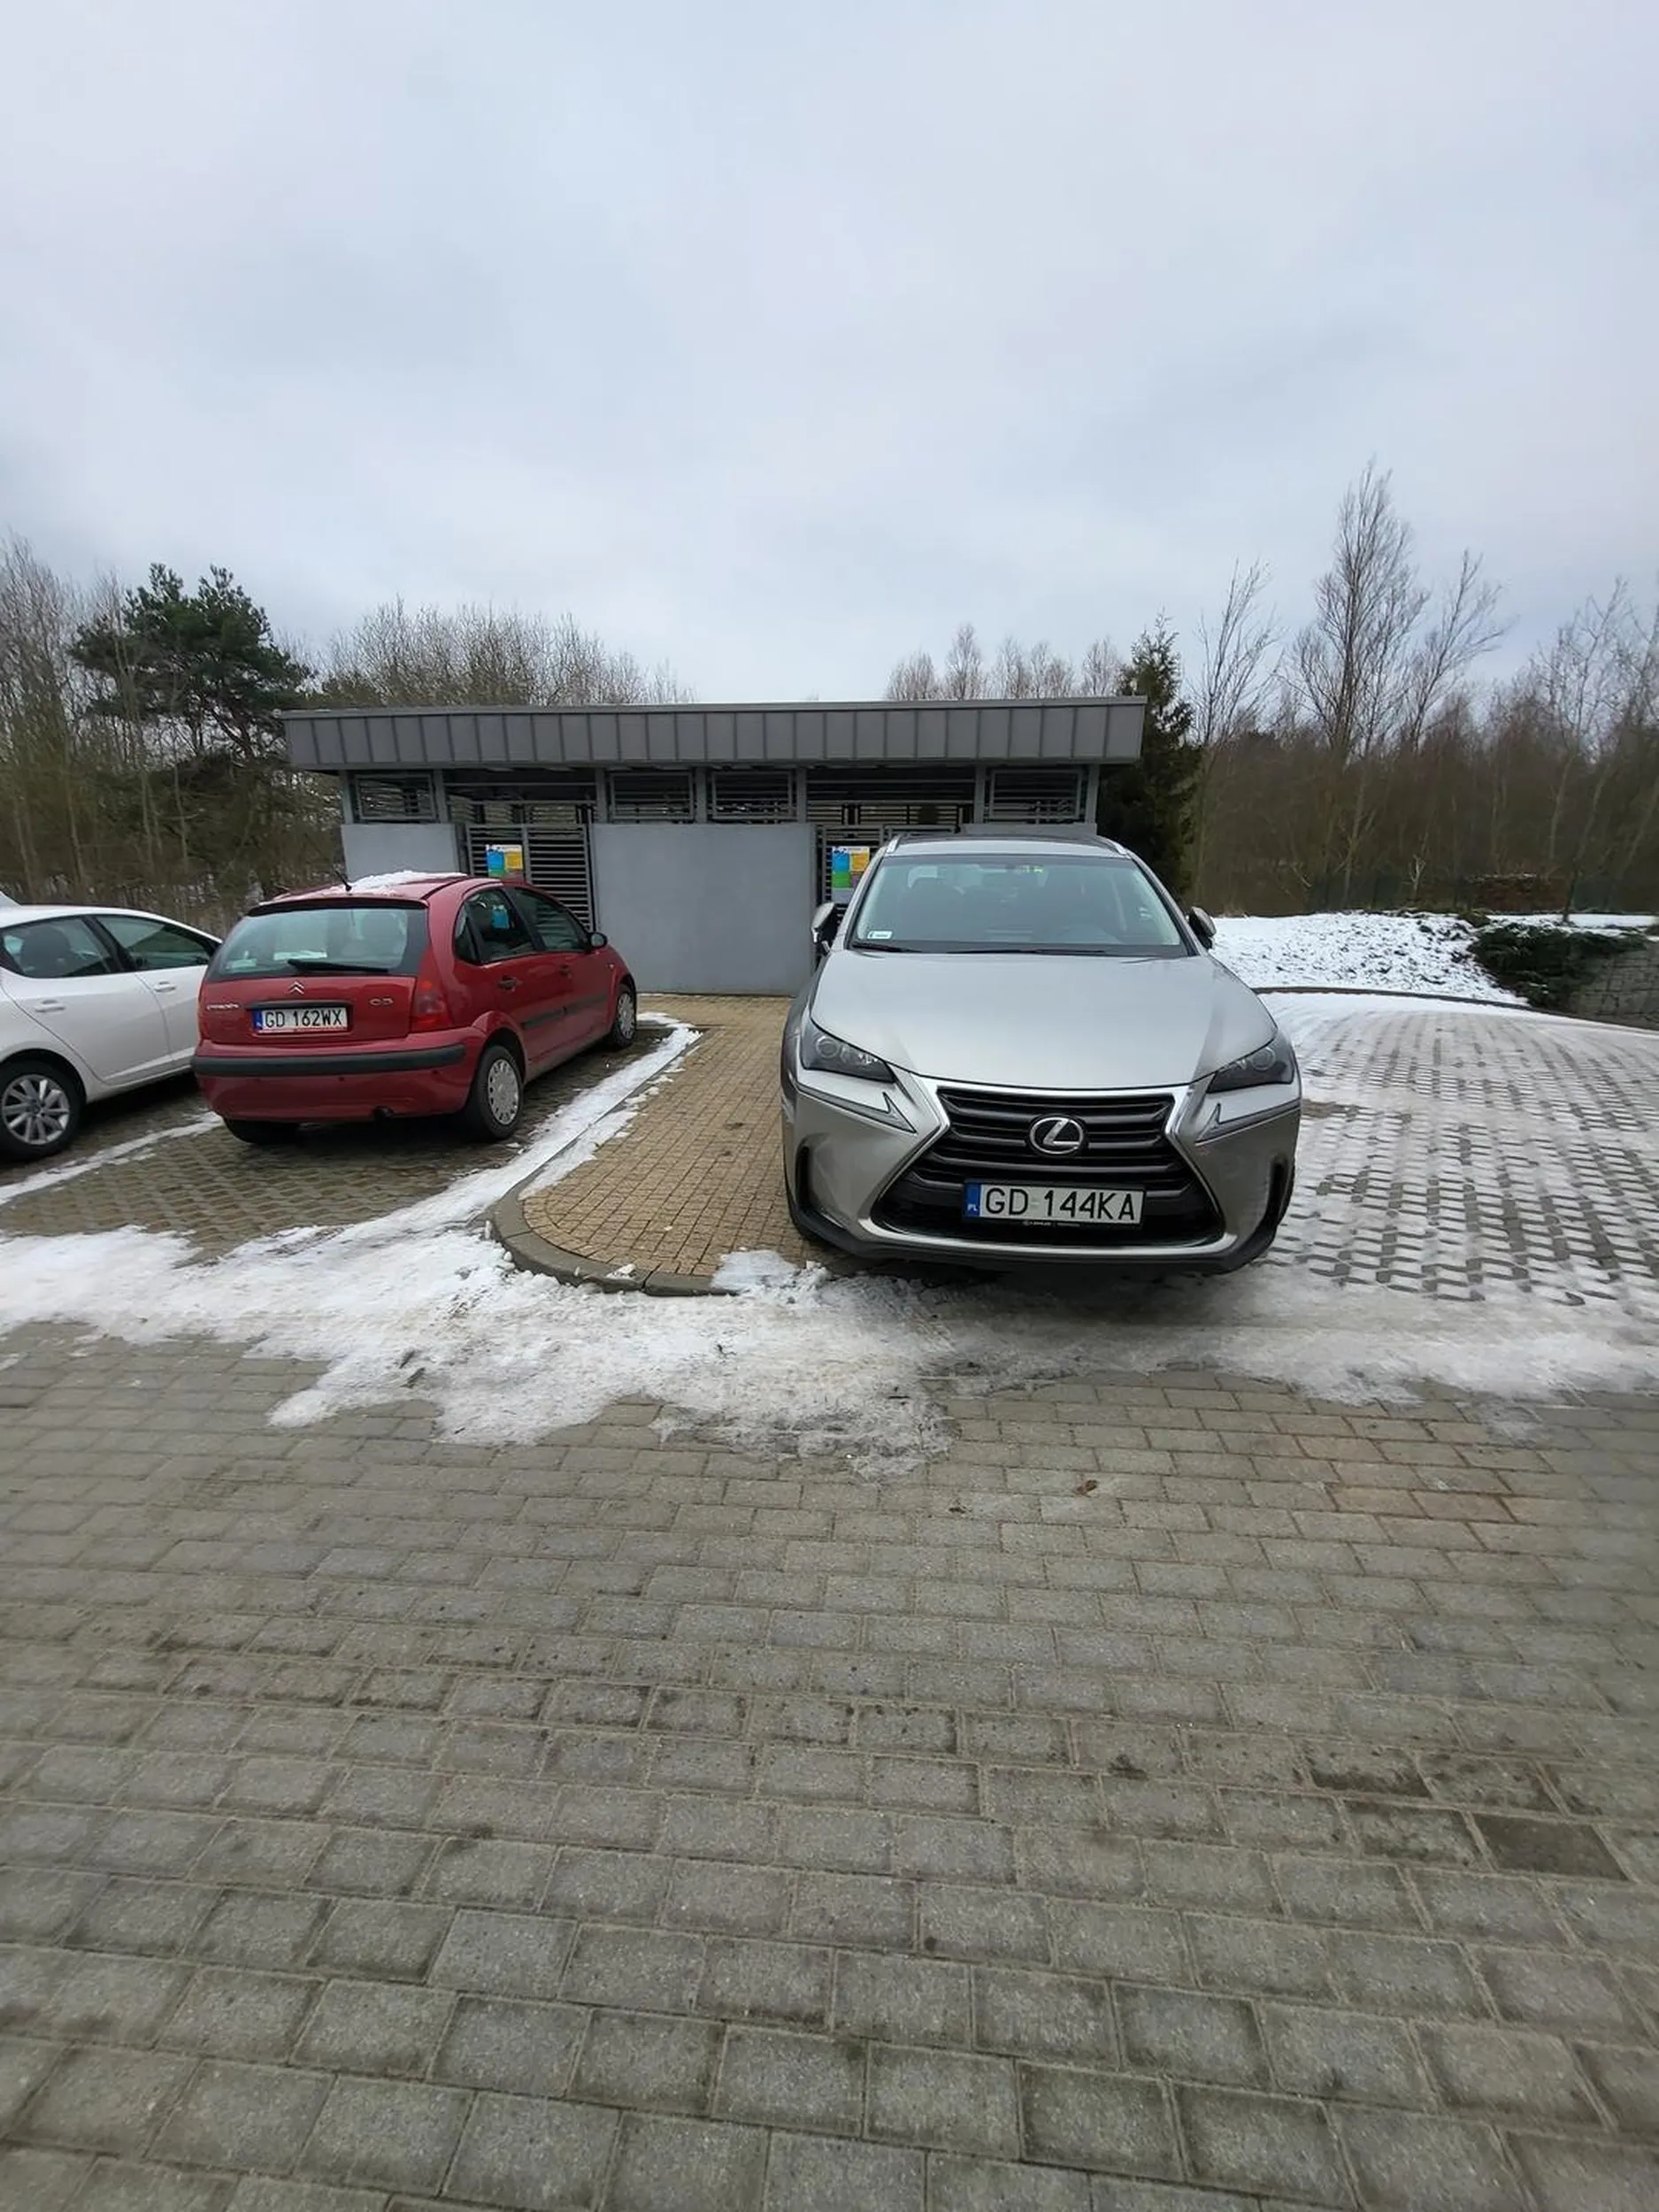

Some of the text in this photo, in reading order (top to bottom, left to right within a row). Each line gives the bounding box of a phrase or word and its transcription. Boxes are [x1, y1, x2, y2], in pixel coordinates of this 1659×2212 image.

[265, 1010, 342, 1028] GD 162WX
[985, 1187, 1135, 1221] GD 144KA
